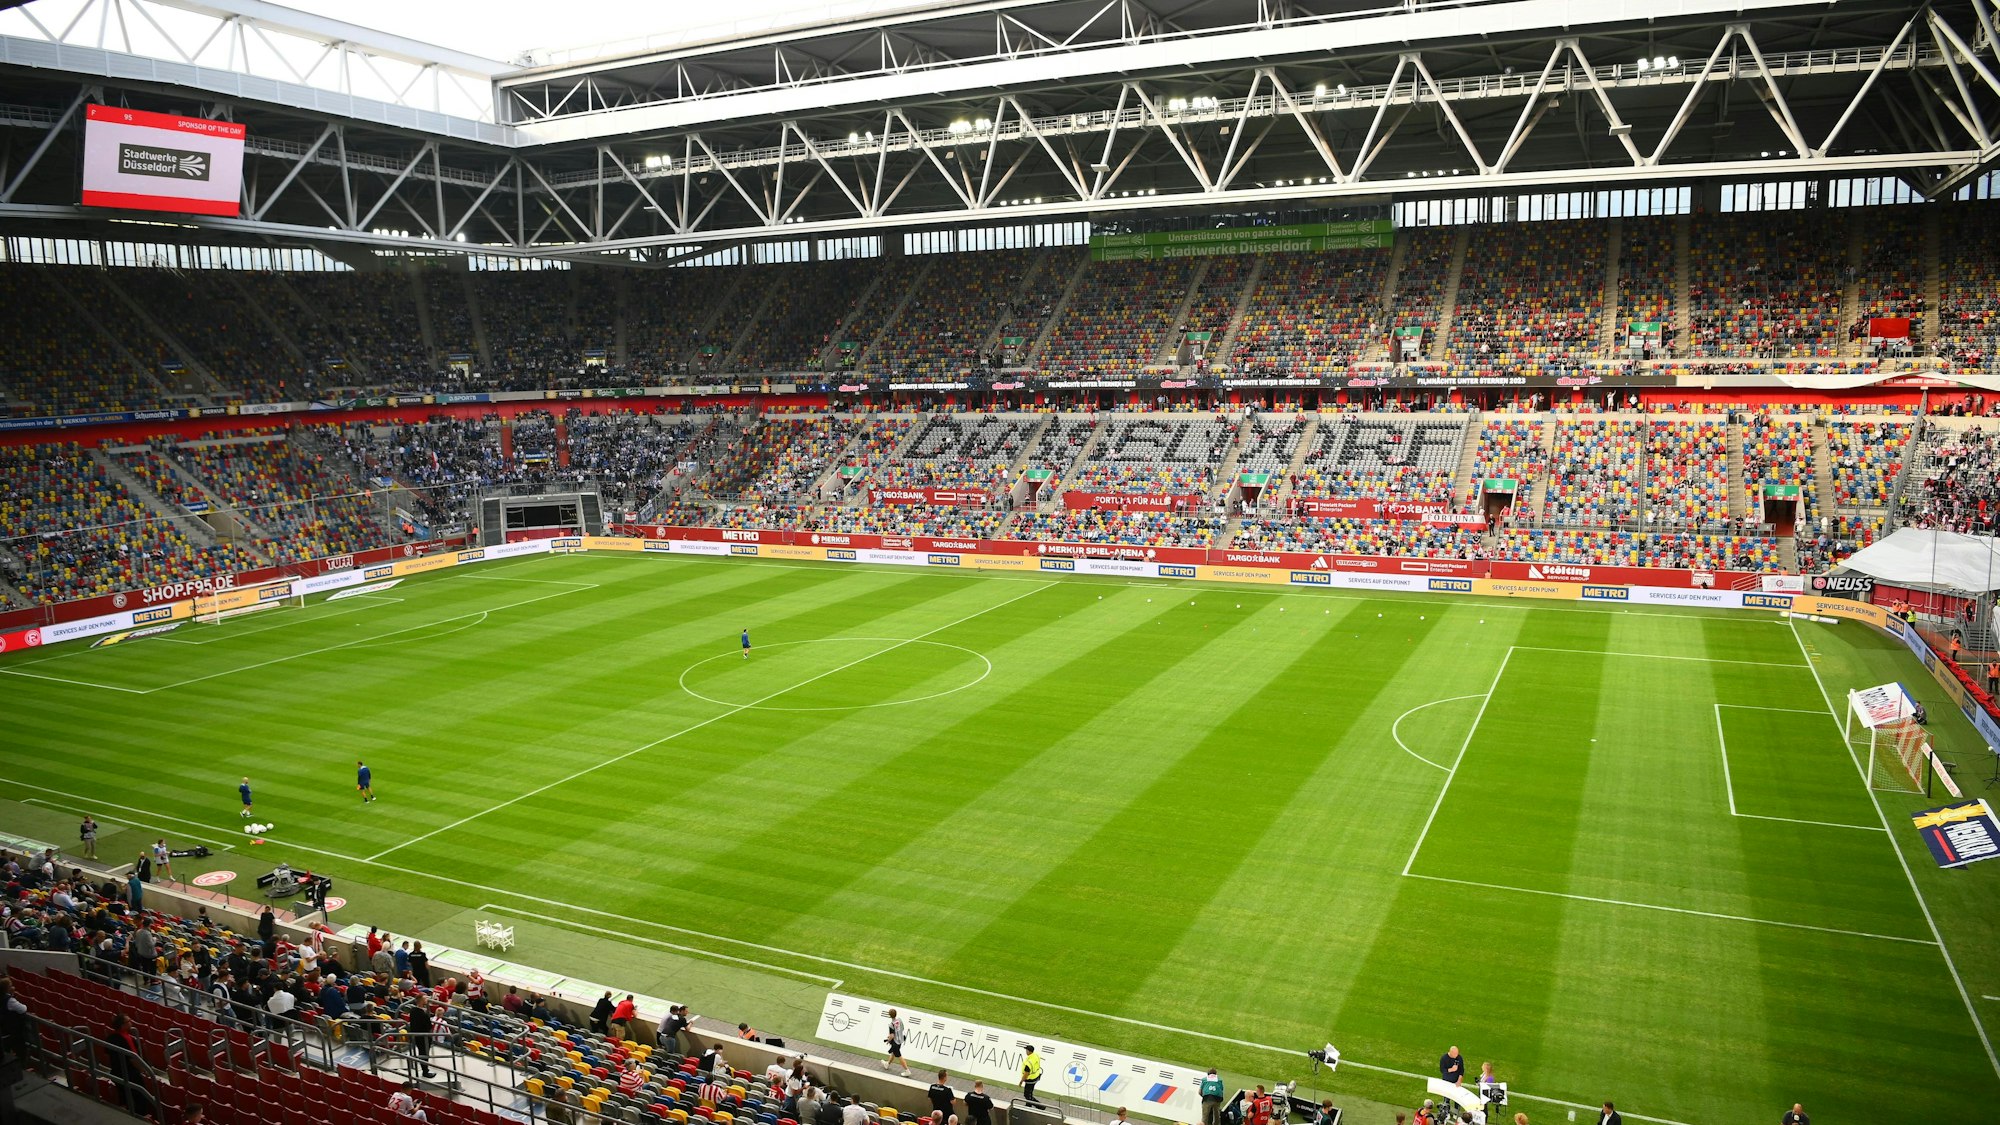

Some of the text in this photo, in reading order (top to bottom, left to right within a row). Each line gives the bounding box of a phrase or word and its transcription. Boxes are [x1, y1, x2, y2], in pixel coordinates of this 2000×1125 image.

[178, 120, 206, 130] SPONSOR
[230, 127, 242, 135] DAY
[124, 148, 177, 162] Stadtwerke
[123, 159, 176, 173] Düsseldorf
[1168, 232, 1232, 242] Unterstützung
[1252, 230, 1274, 239] ganz
[1276, 228, 1301, 236] oben.
[1164, 239, 1312, 258] Stadtwerke Düsseldorf
[1328, 242, 1358, 250] Düsseldorf
[1160, 380, 1186, 388] alltours
[1348, 378, 1376, 386] alltours
[1417, 378, 1456, 386] FILMNÄCHTE
[1557, 377, 1588, 386] alltours
[134, 412, 169, 420] Schumacher
[1133, 496, 1148, 505] FÜR
[1427, 514, 1476, 522] FORTUNA
[722, 530, 760, 542] METRO
[821, 536, 850, 544] MERKUR
[552, 538, 581, 548] METRO
[645, 541, 669, 550] METRO
[731, 546, 758, 554] METRO
[828, 550, 856, 559] METRO
[1048, 545, 1144, 557] MERKUR SPIEL-ARENA
[458, 551, 484, 562] METRO
[929, 555, 959, 564] METRO
[326, 554, 354, 570] TUFFI
[1042, 560, 1074, 570] METRO
[365, 567, 392, 578] METRO
[1160, 567, 1194, 576] METRO
[1542, 566, 1590, 578] Stölting
[1292, 573, 1330, 583] METRO
[142, 574, 234, 603] SHOP.F95.DE
[1430, 580, 1470, 590] METRO
[1826, 577, 1872, 592] NEUSS
[261, 586, 290, 599] METRO
[1584, 588, 1627, 598] METRO
[1744, 596, 1791, 607] METRO
[1816, 602, 1845, 610] SERVICES
[134, 609, 171, 622] METRO
[53, 628, 78, 636] SERVICES
[834, 1018, 848, 1026] MINI
[904, 1028, 1024, 1072] MMERMANN
[390, 1097, 402, 1110] 23
